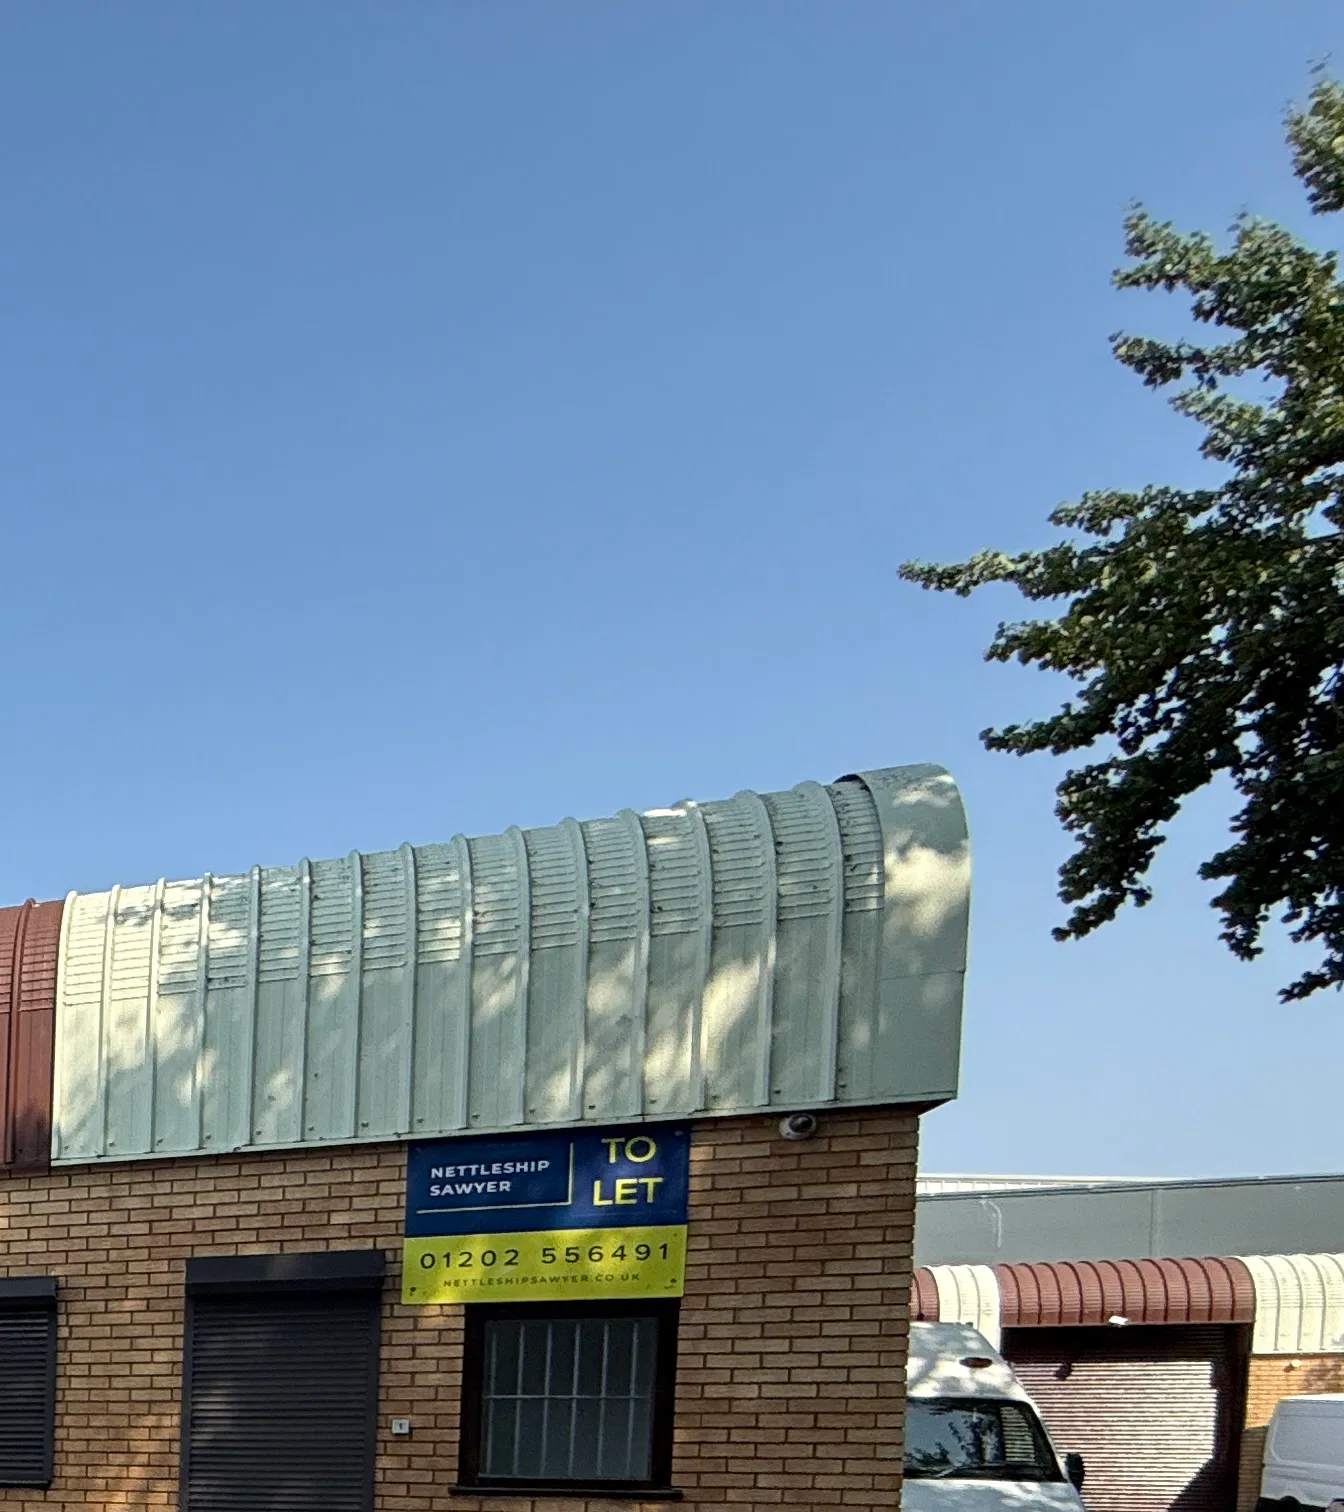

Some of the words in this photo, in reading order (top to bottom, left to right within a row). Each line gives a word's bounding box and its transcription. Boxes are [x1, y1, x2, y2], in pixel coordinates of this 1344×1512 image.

[601, 1136, 657, 1164] TO
[430, 1160, 551, 1179] NETTLESHIP
[429, 1180, 512, 1197] SAWYER
[593, 1177, 663, 1207] LET
[420, 1249, 520, 1270] 01202
[541, 1243, 669, 1265] 556491
